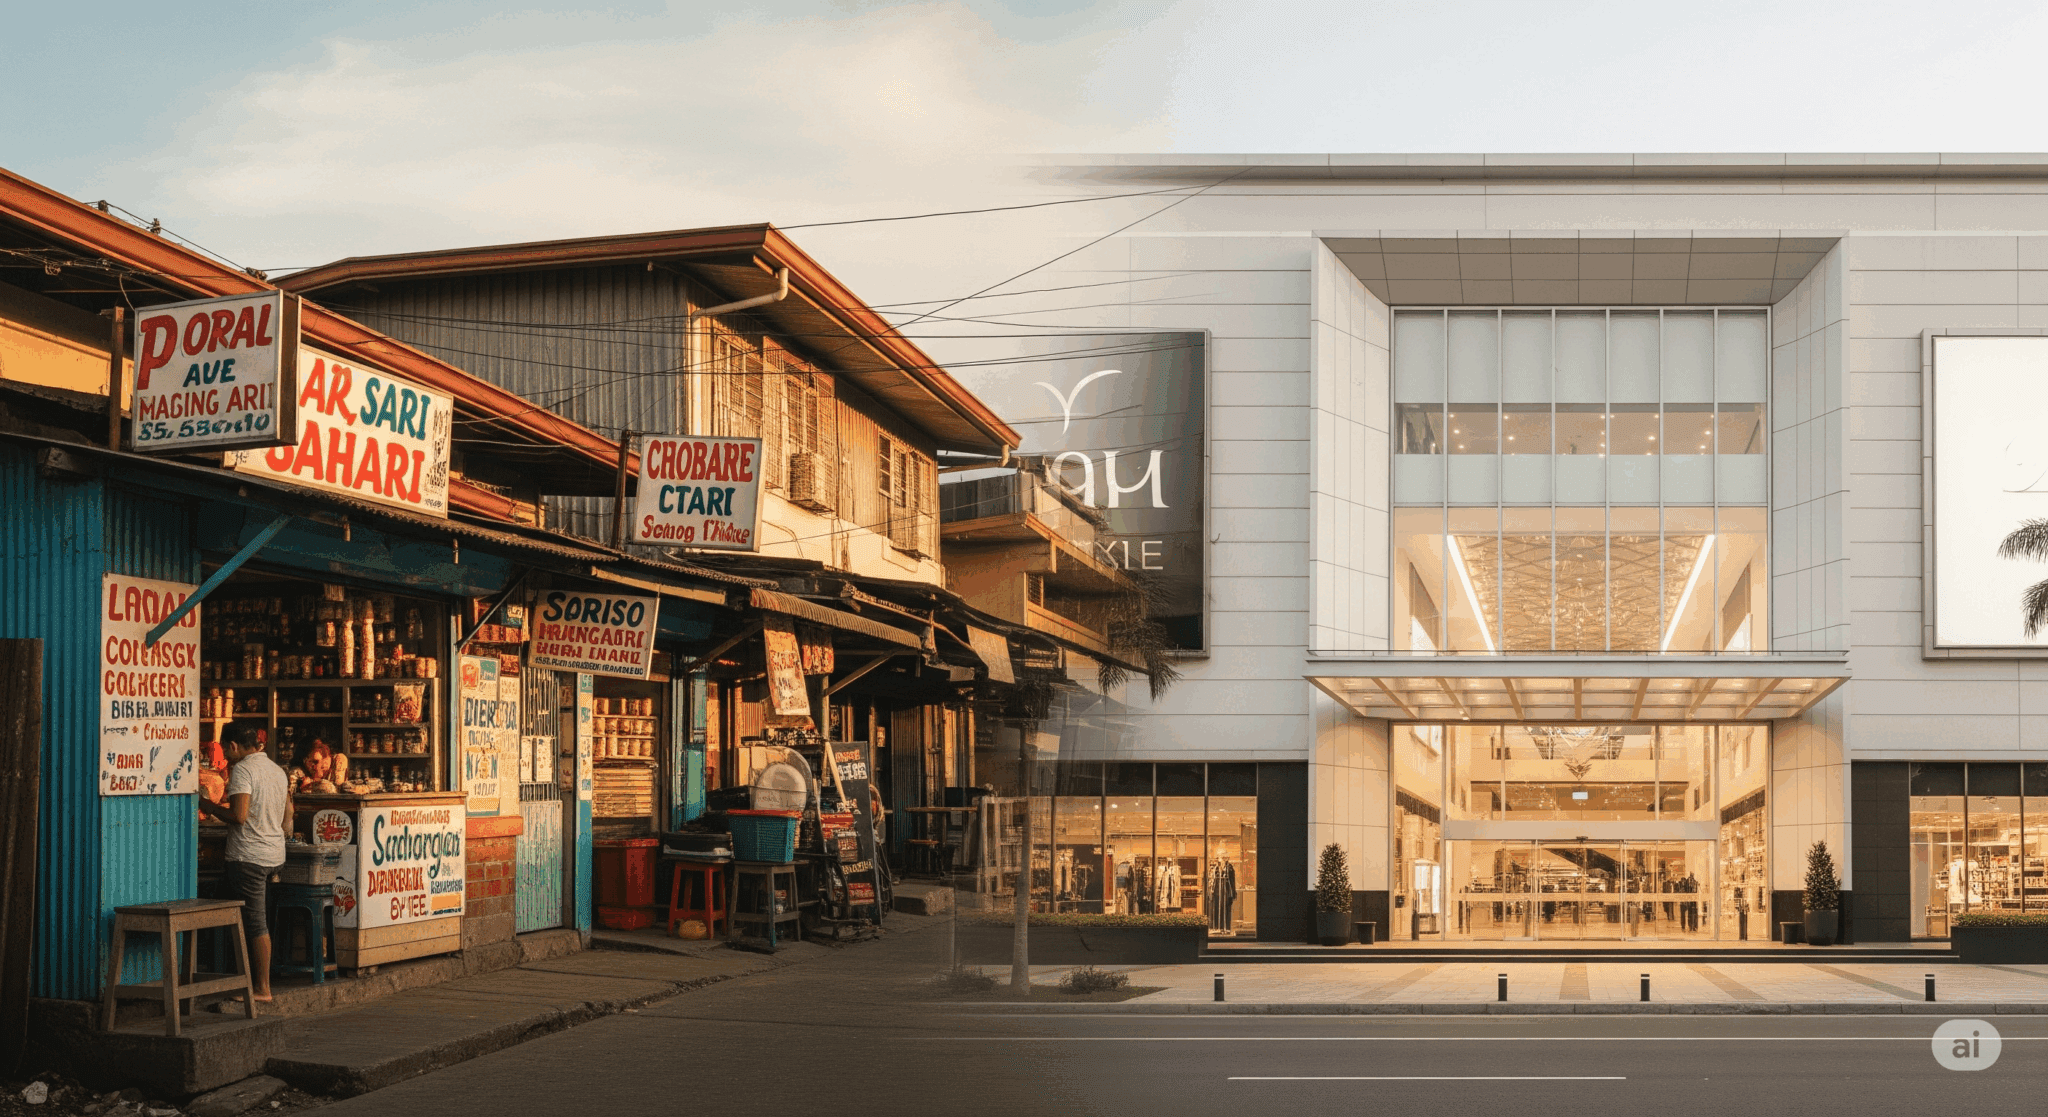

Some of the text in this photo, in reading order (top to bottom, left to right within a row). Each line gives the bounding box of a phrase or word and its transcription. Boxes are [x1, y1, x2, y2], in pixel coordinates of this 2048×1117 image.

[139, 388, 219, 421] MAGING
[360, 376, 431, 440] SARI
[647, 440, 755, 482] CHOBARE
[659, 484, 736, 517] CTARI
